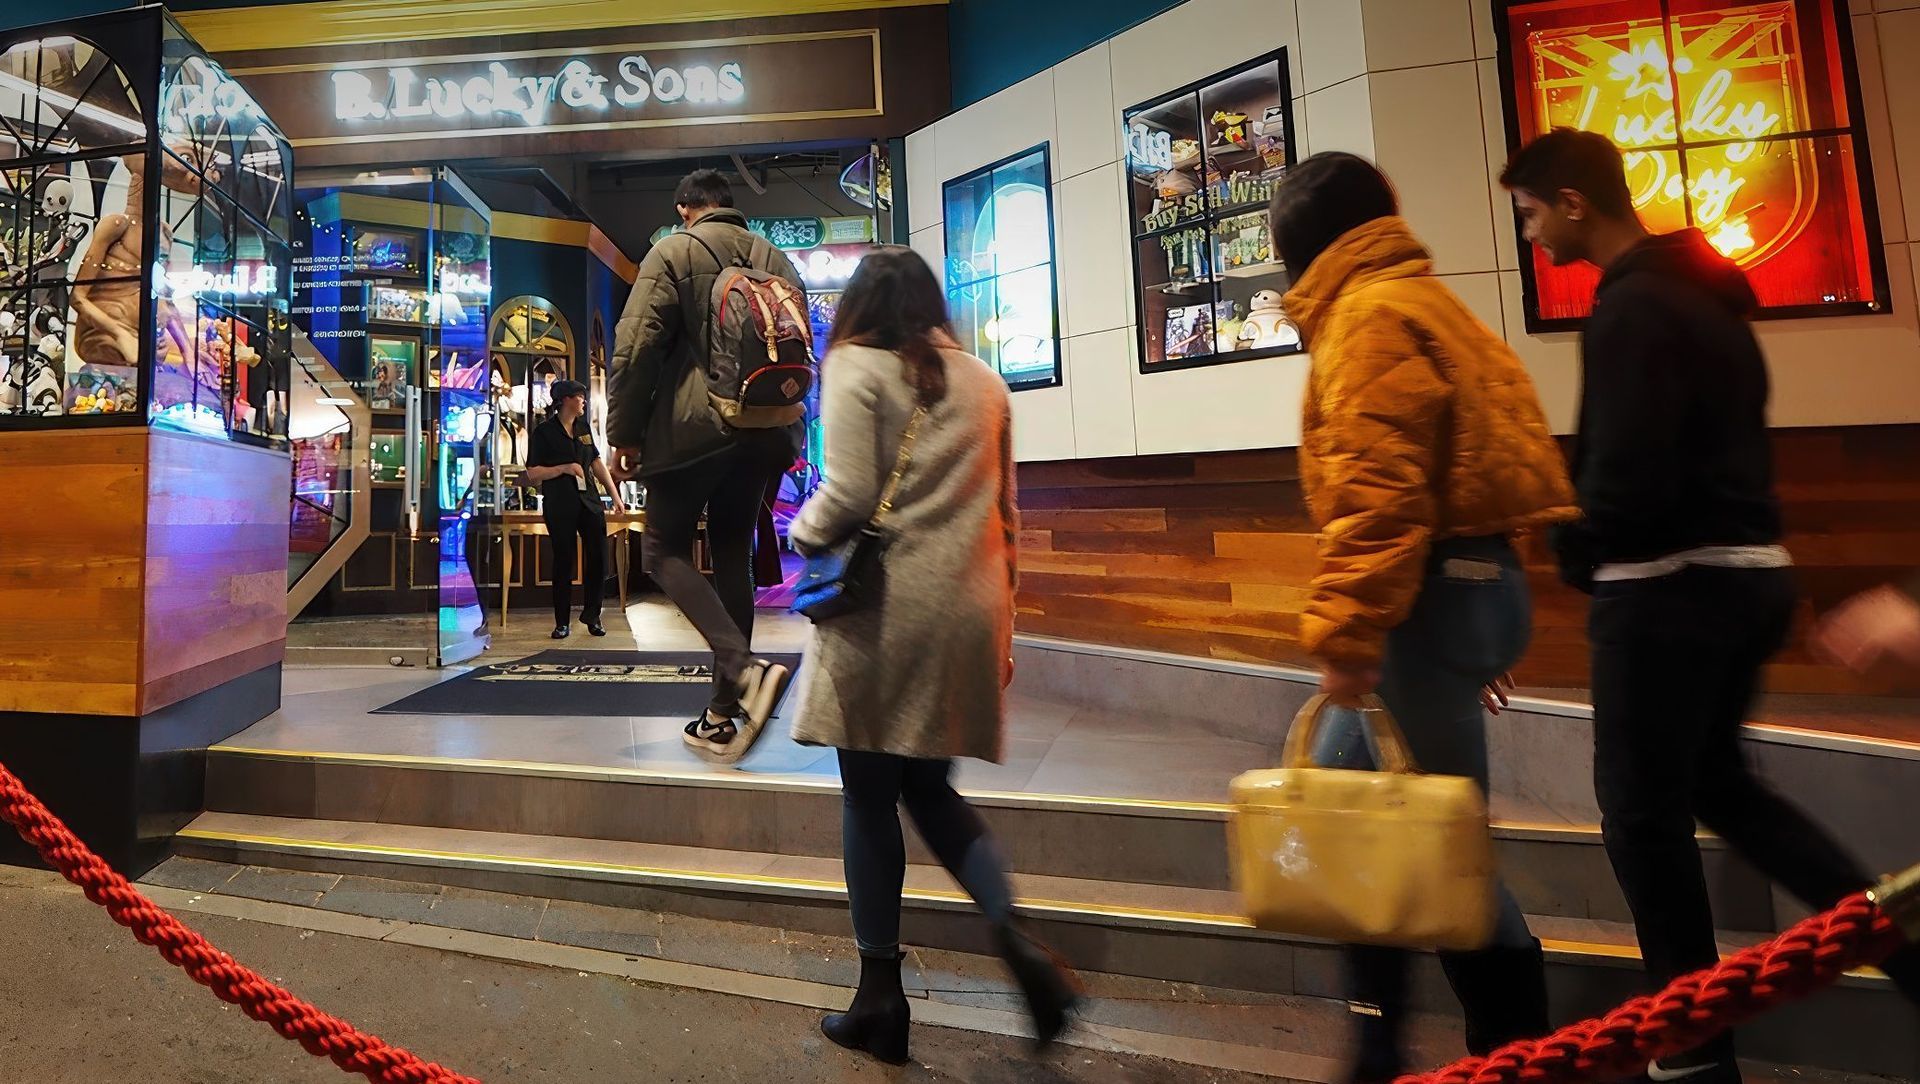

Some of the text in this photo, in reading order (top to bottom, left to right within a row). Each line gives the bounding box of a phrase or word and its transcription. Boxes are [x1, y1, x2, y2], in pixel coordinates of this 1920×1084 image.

[559, 59, 609, 110] &
[614, 54, 745, 106] Sons
[1141, 205, 1178, 233] Buy
